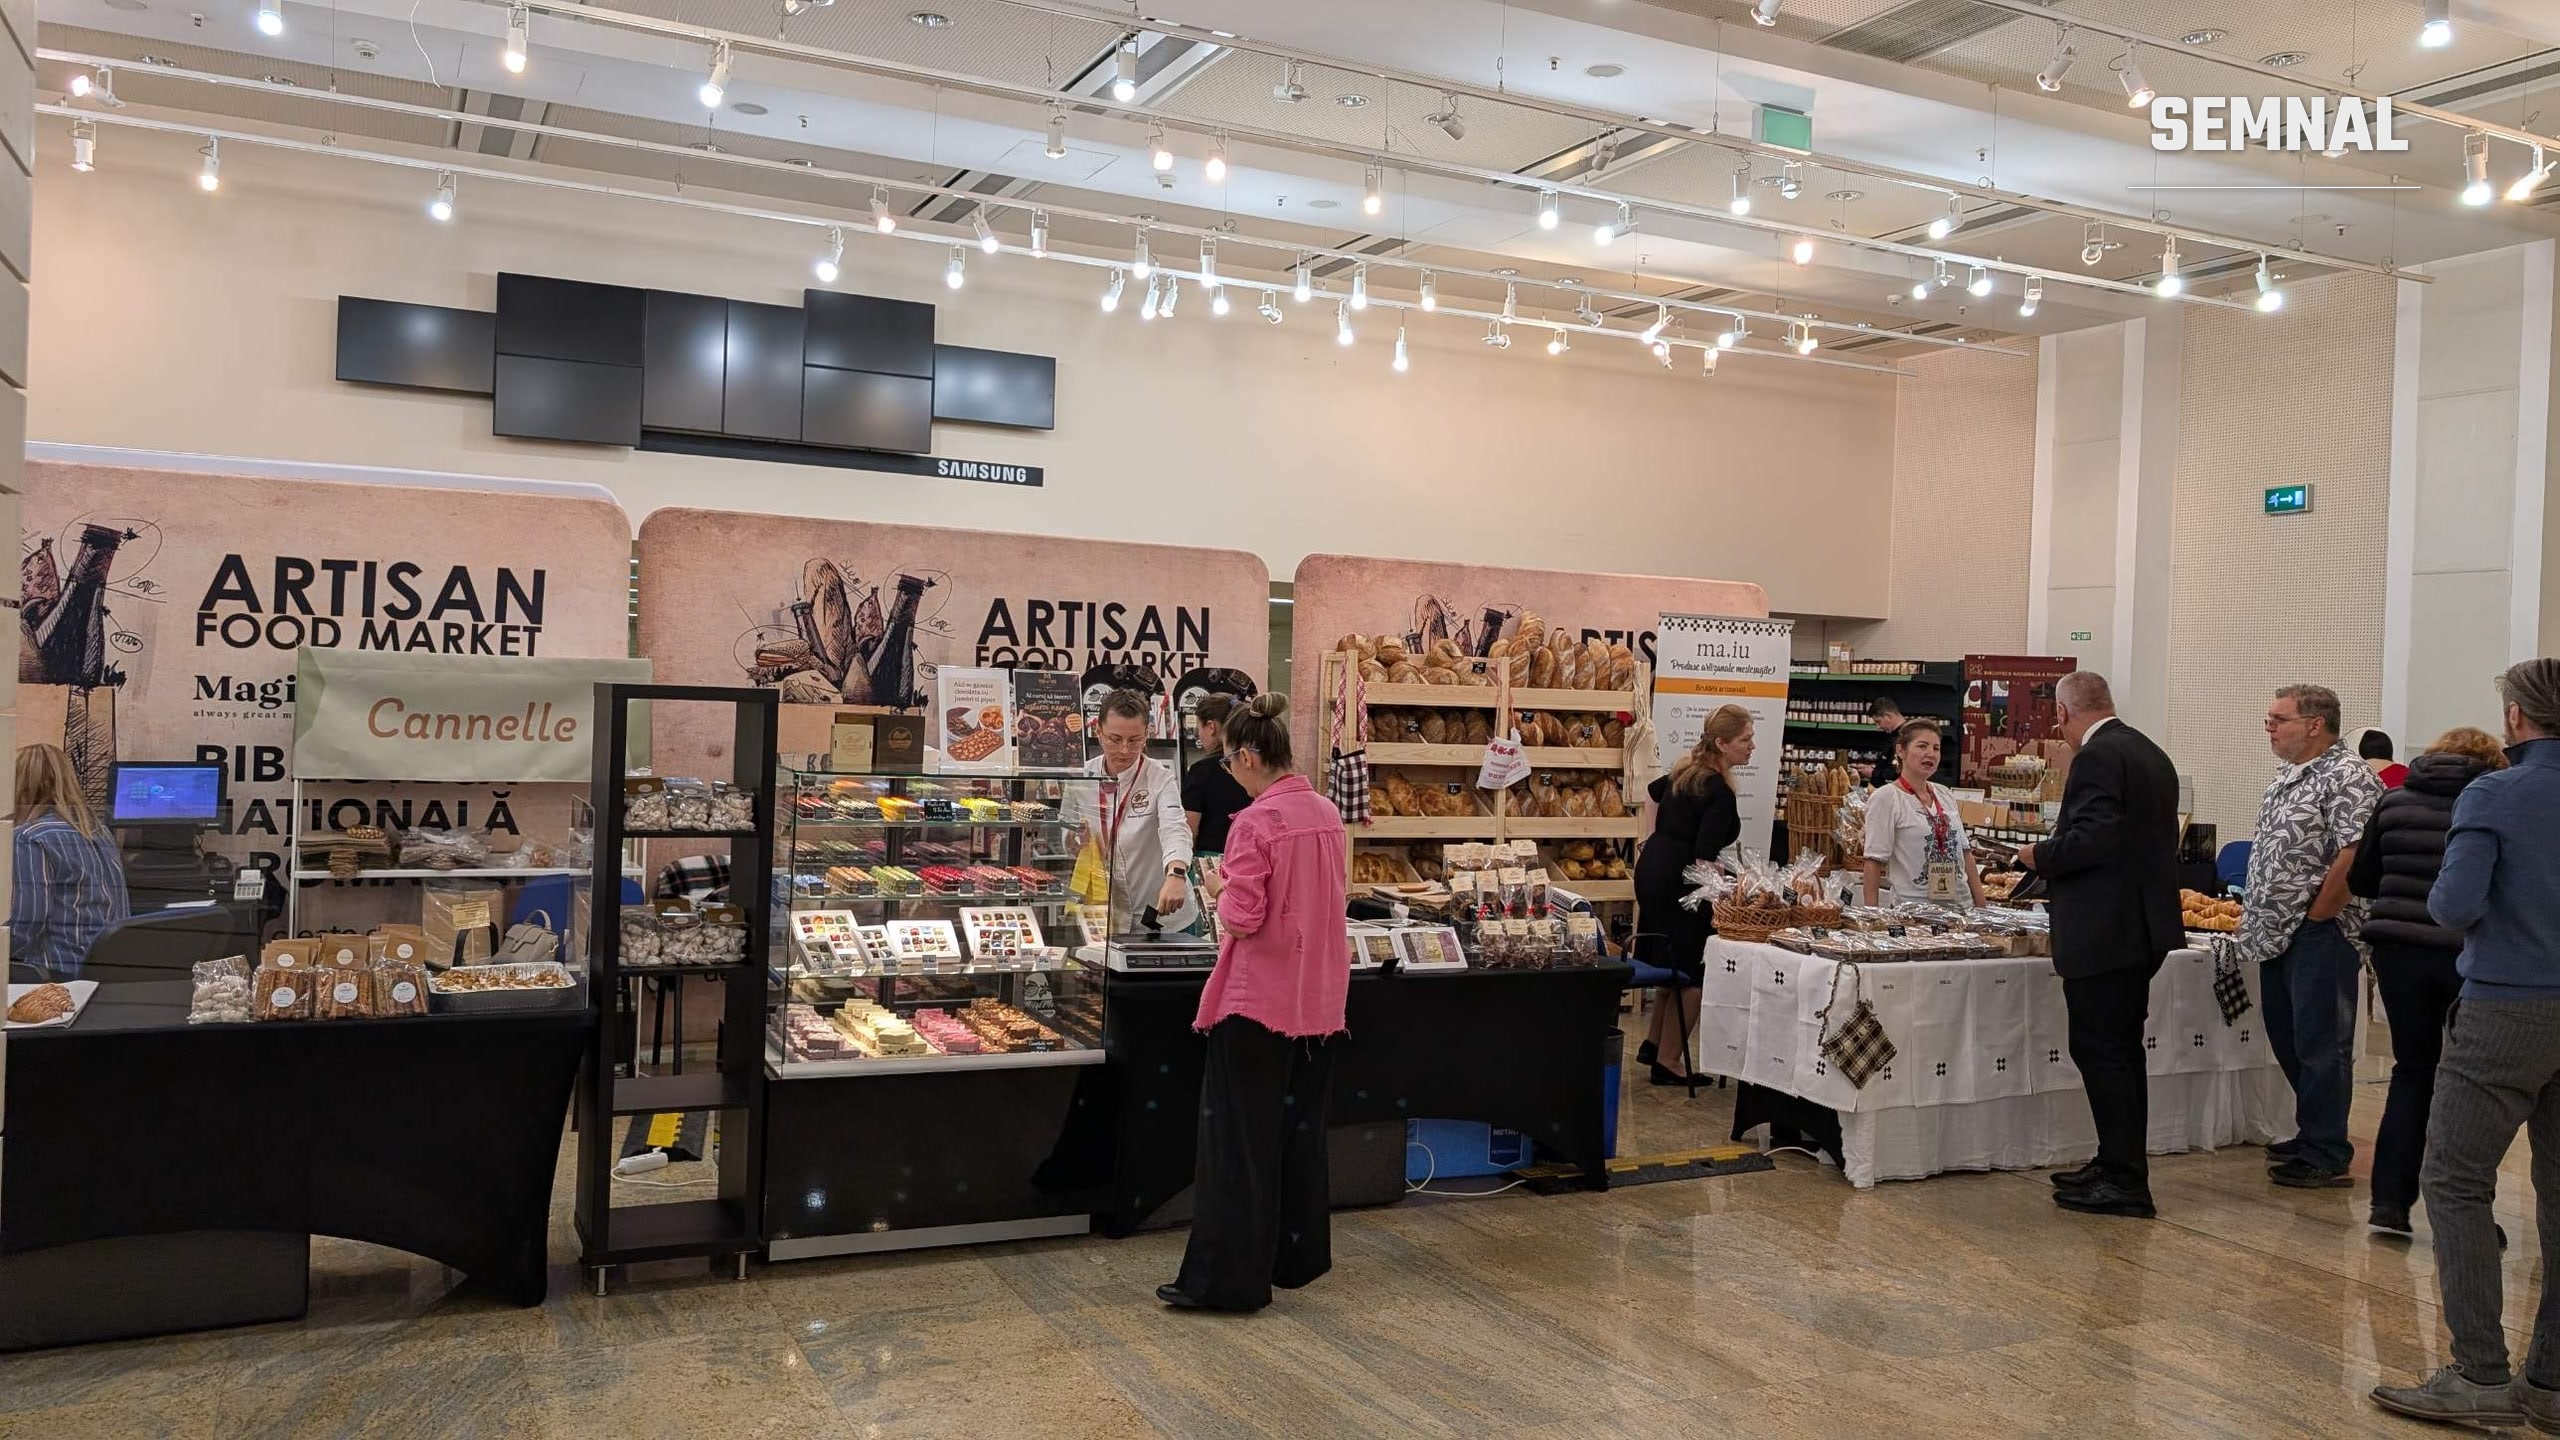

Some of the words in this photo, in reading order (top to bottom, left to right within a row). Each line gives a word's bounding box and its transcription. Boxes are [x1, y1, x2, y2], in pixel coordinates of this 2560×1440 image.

[938, 460, 1027, 483] SAMSUNG
[199, 554, 546, 625] ARTISAN
[195, 612, 342, 650] FOOD
[358, 619, 542, 657] MARKET
[976, 597, 1210, 652] ARTISAN
[1696, 641, 1750, 659] ma.iu
[193, 709, 238, 720] always
[243, 711, 277, 720] great
[368, 697, 577, 742] Cannelle
